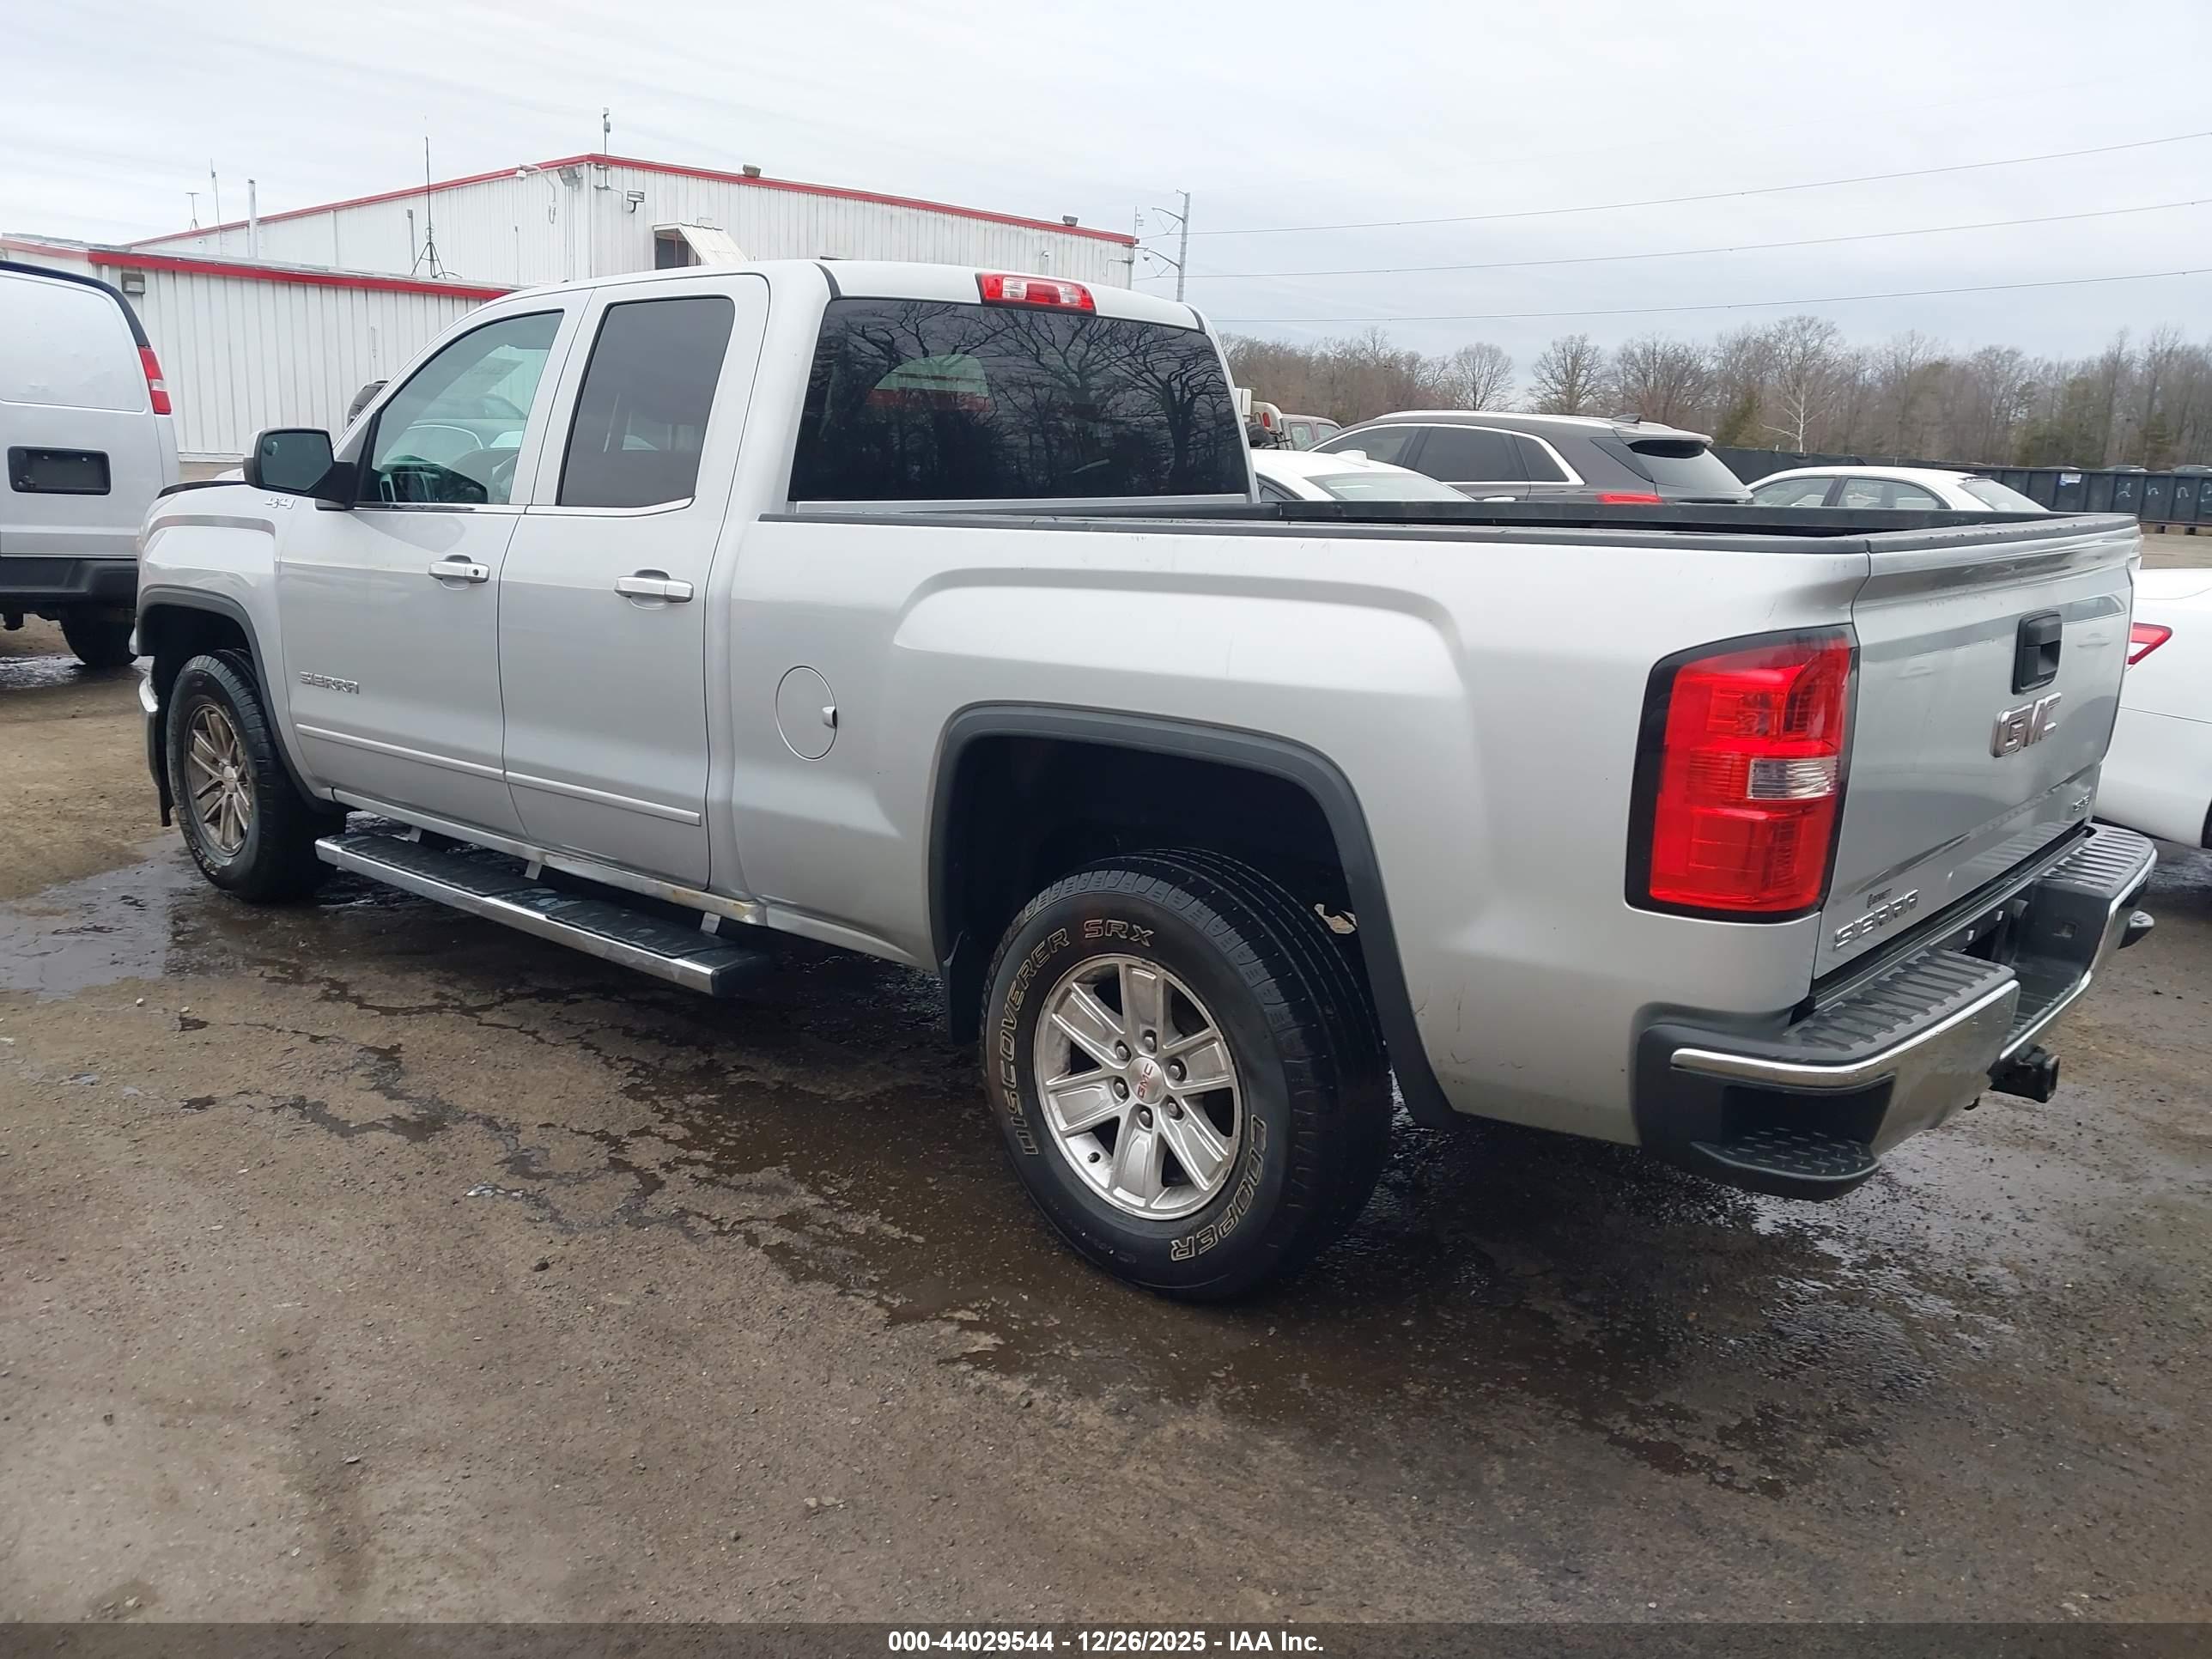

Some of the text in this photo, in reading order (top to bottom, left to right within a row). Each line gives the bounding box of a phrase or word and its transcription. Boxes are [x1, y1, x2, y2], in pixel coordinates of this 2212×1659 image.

[299, 671, 360, 694] SIERRA
[1990, 692, 2062, 757] GMC
[1833, 888, 1919, 951] SIERRA
[1000, 918, 1155, 1155] DISCOVERER SRX
[1137, 1062, 1154, 1099] GMC
[1170, 1114, 1267, 1262] COOPER
